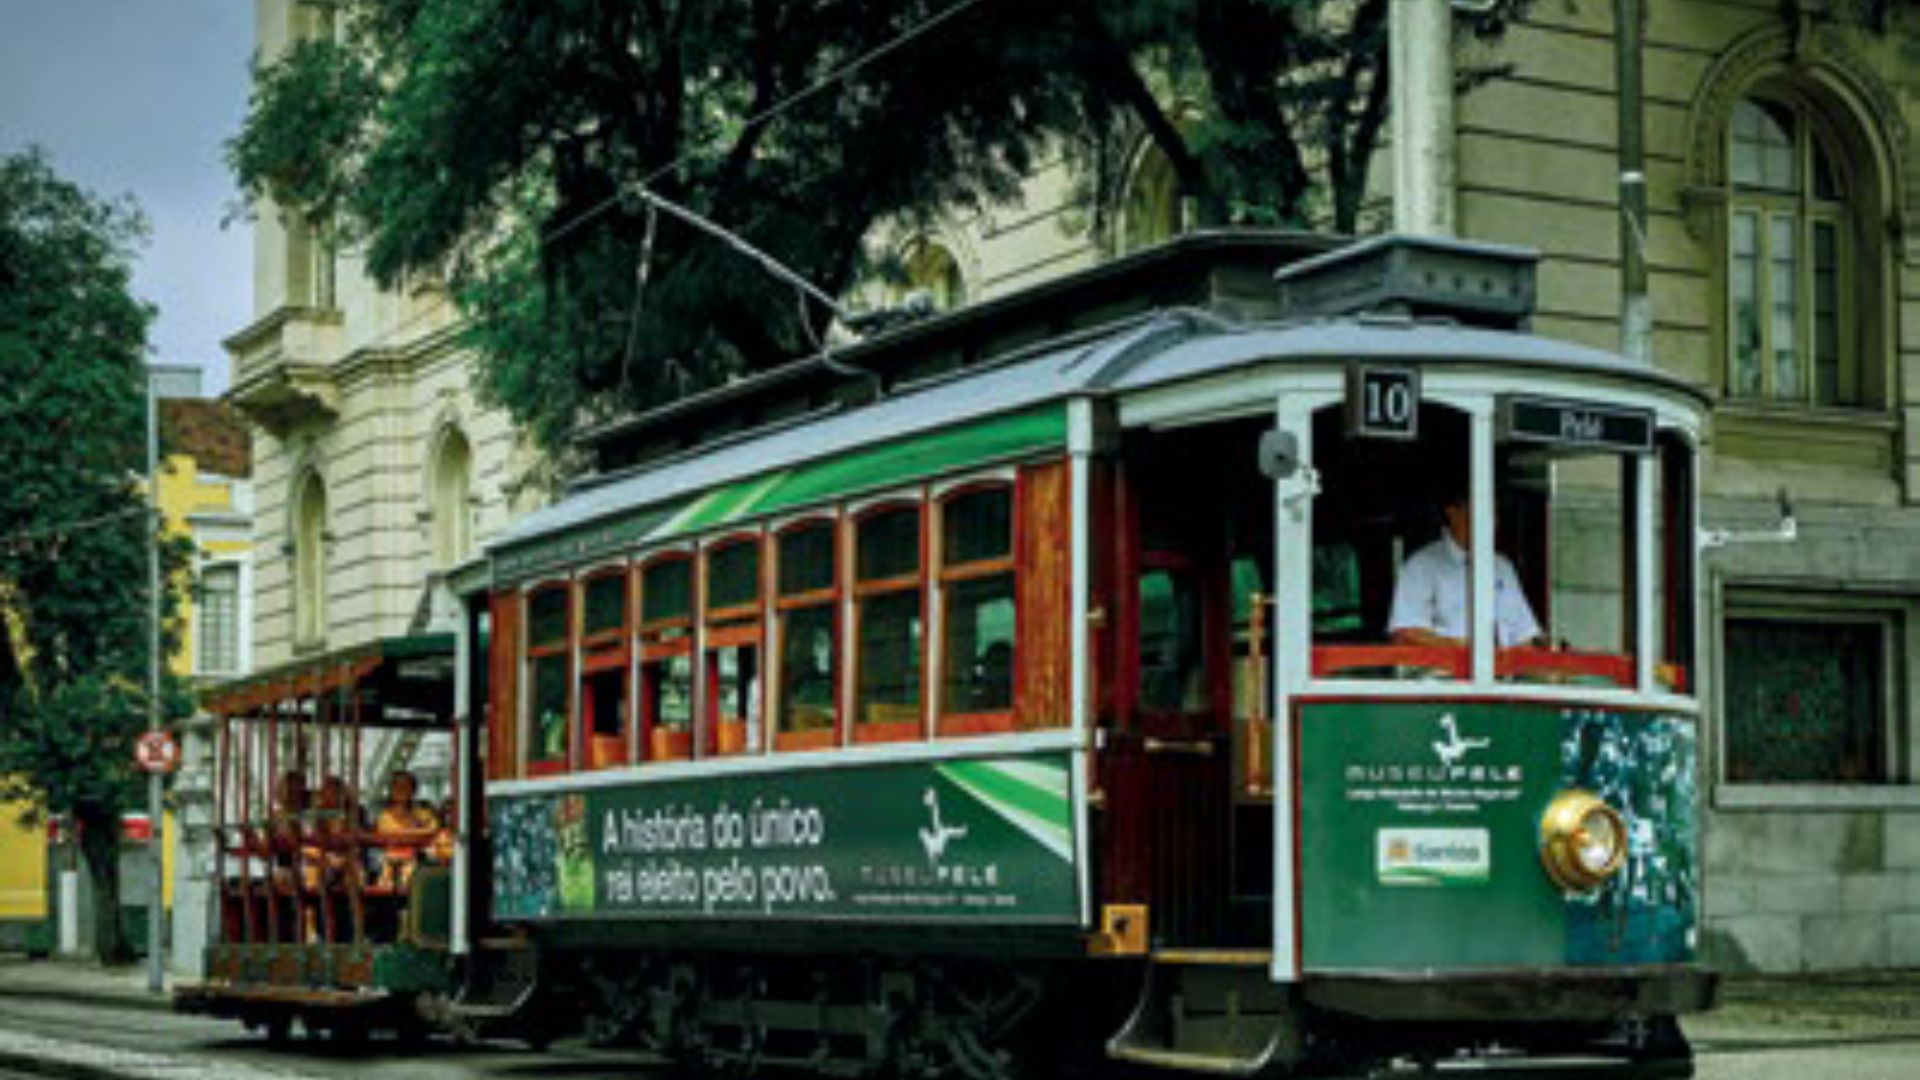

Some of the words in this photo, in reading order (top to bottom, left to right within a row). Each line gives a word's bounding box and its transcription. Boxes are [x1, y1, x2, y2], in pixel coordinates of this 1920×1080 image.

[1367, 381, 1410, 424] 10
[603, 808, 619, 853] A
[622, 803, 708, 851] história
[712, 802, 744, 849] do
[751, 797, 825, 847] único
[606, 858, 634, 902] rei
[636, 857, 700, 902] eleito
[703, 856, 757, 915] pelo
[760, 865, 837, 915] povo.
